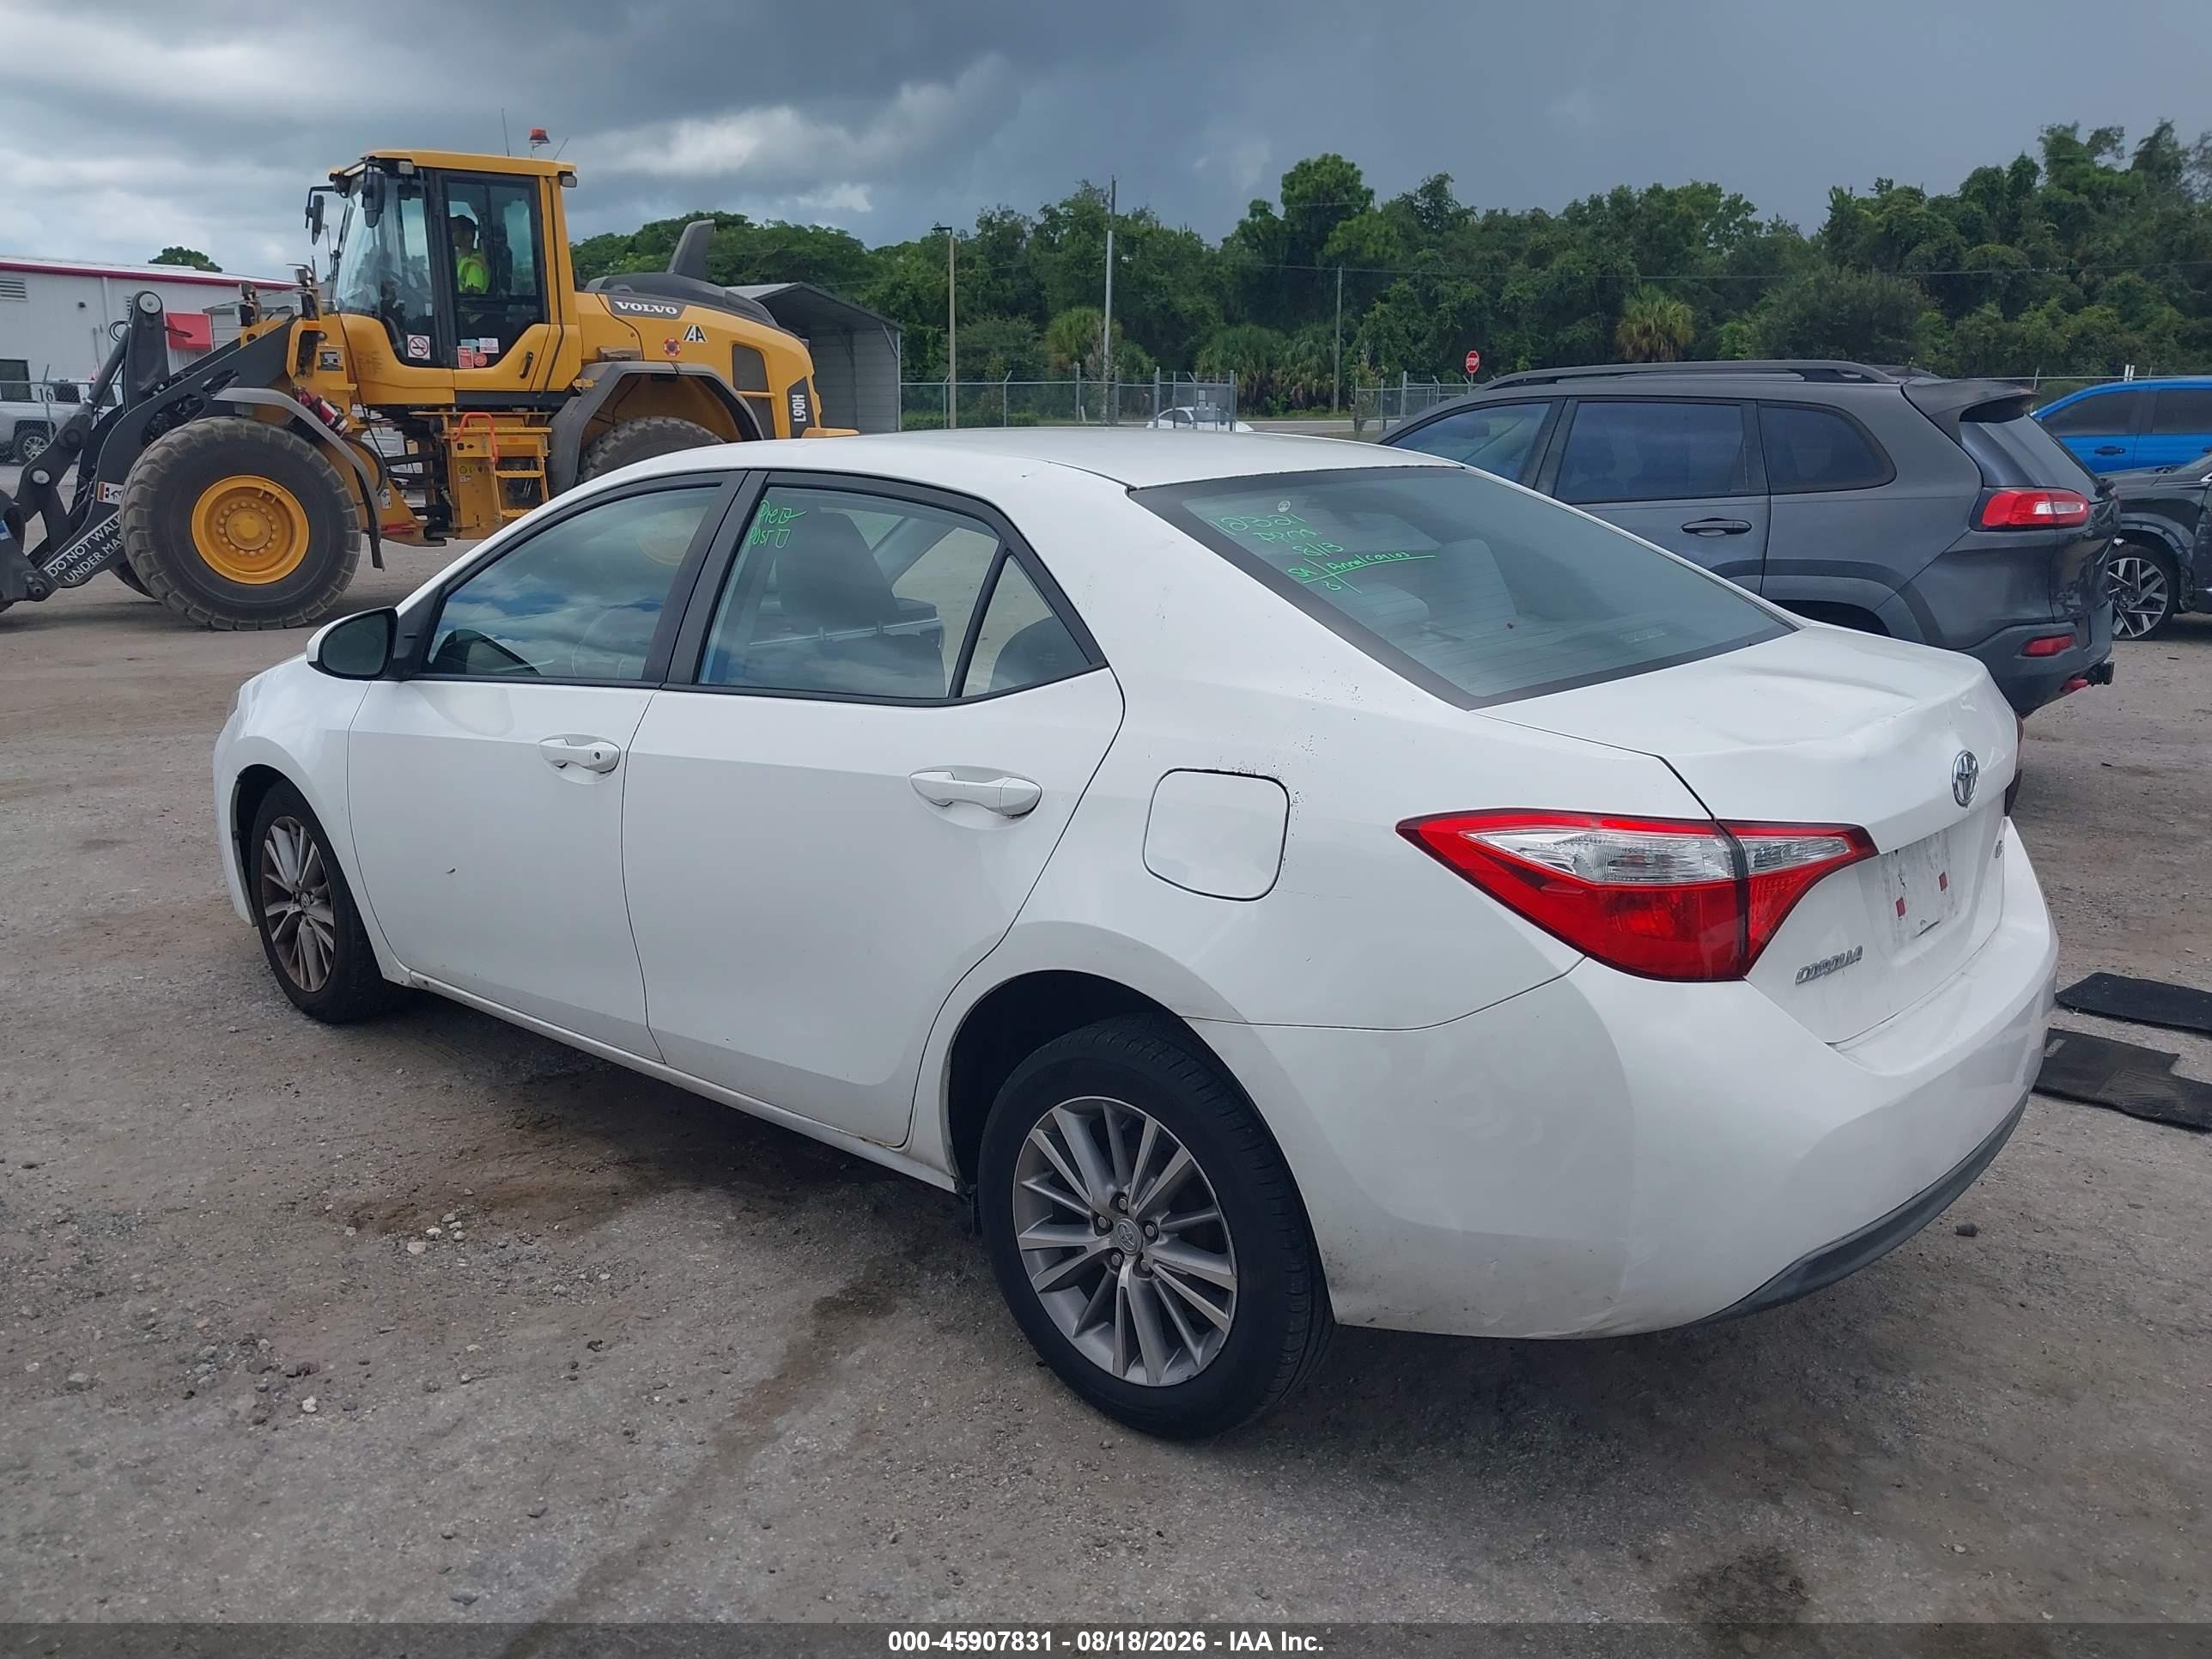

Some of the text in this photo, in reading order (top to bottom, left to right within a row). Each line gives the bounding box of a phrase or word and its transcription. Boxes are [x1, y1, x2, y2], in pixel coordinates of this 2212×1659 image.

[614, 301, 678, 314] VOLVO
[40, 387, 53, 402] 16
[792, 394, 806, 422] L90H
[47, 560, 67, 577] DO
[66, 539, 92, 562] NOT
[64, 551, 105, 582] UNDER
